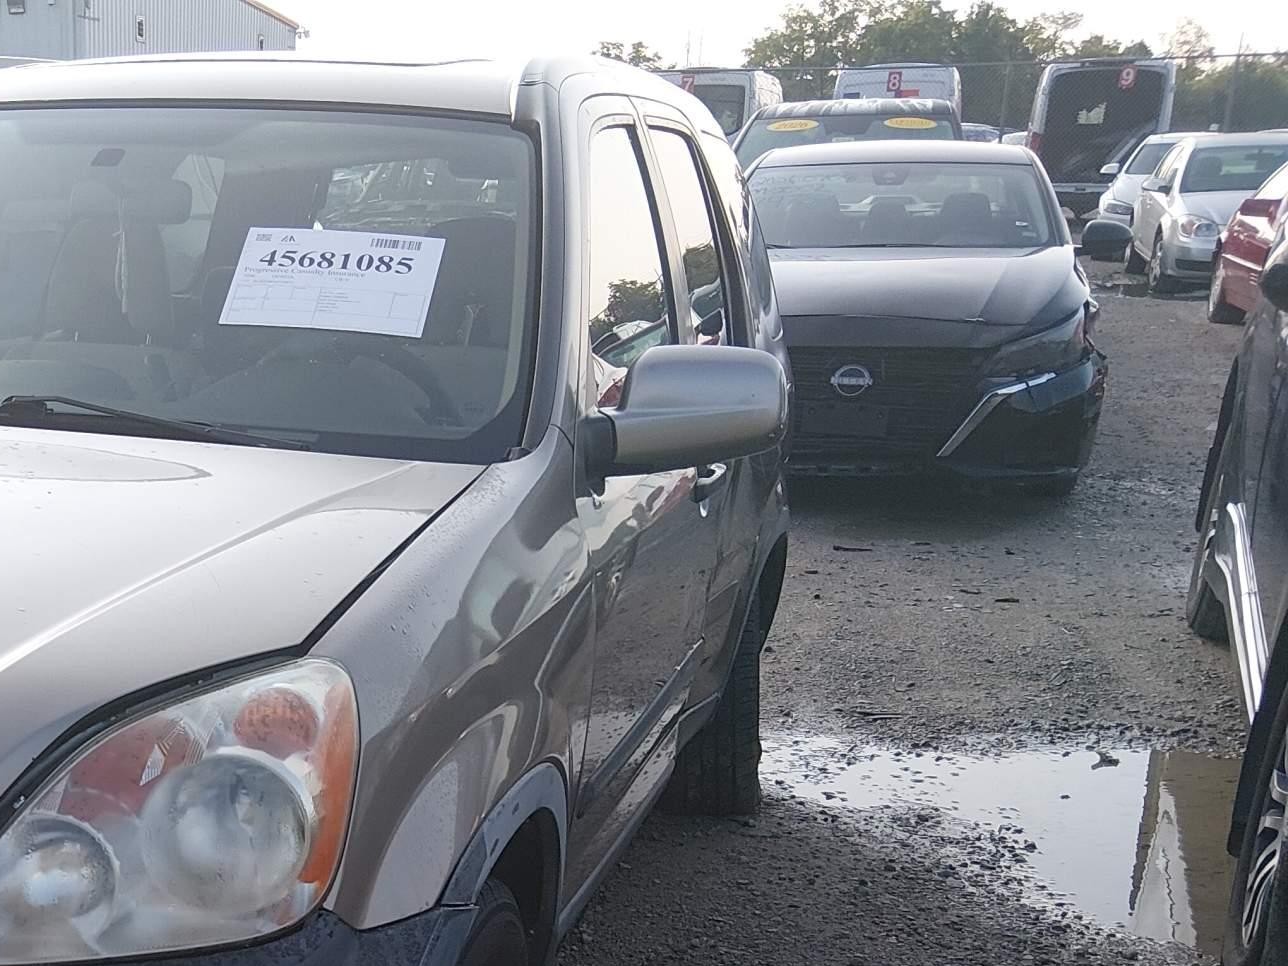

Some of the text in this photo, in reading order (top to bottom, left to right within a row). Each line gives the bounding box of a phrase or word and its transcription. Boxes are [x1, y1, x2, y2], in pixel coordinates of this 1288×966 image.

[683, 77, 694, 90] 7
[888, 73, 900, 90] 8
[1121, 67, 1134, 85] 9
[259, 249, 415, 274] 45681085
